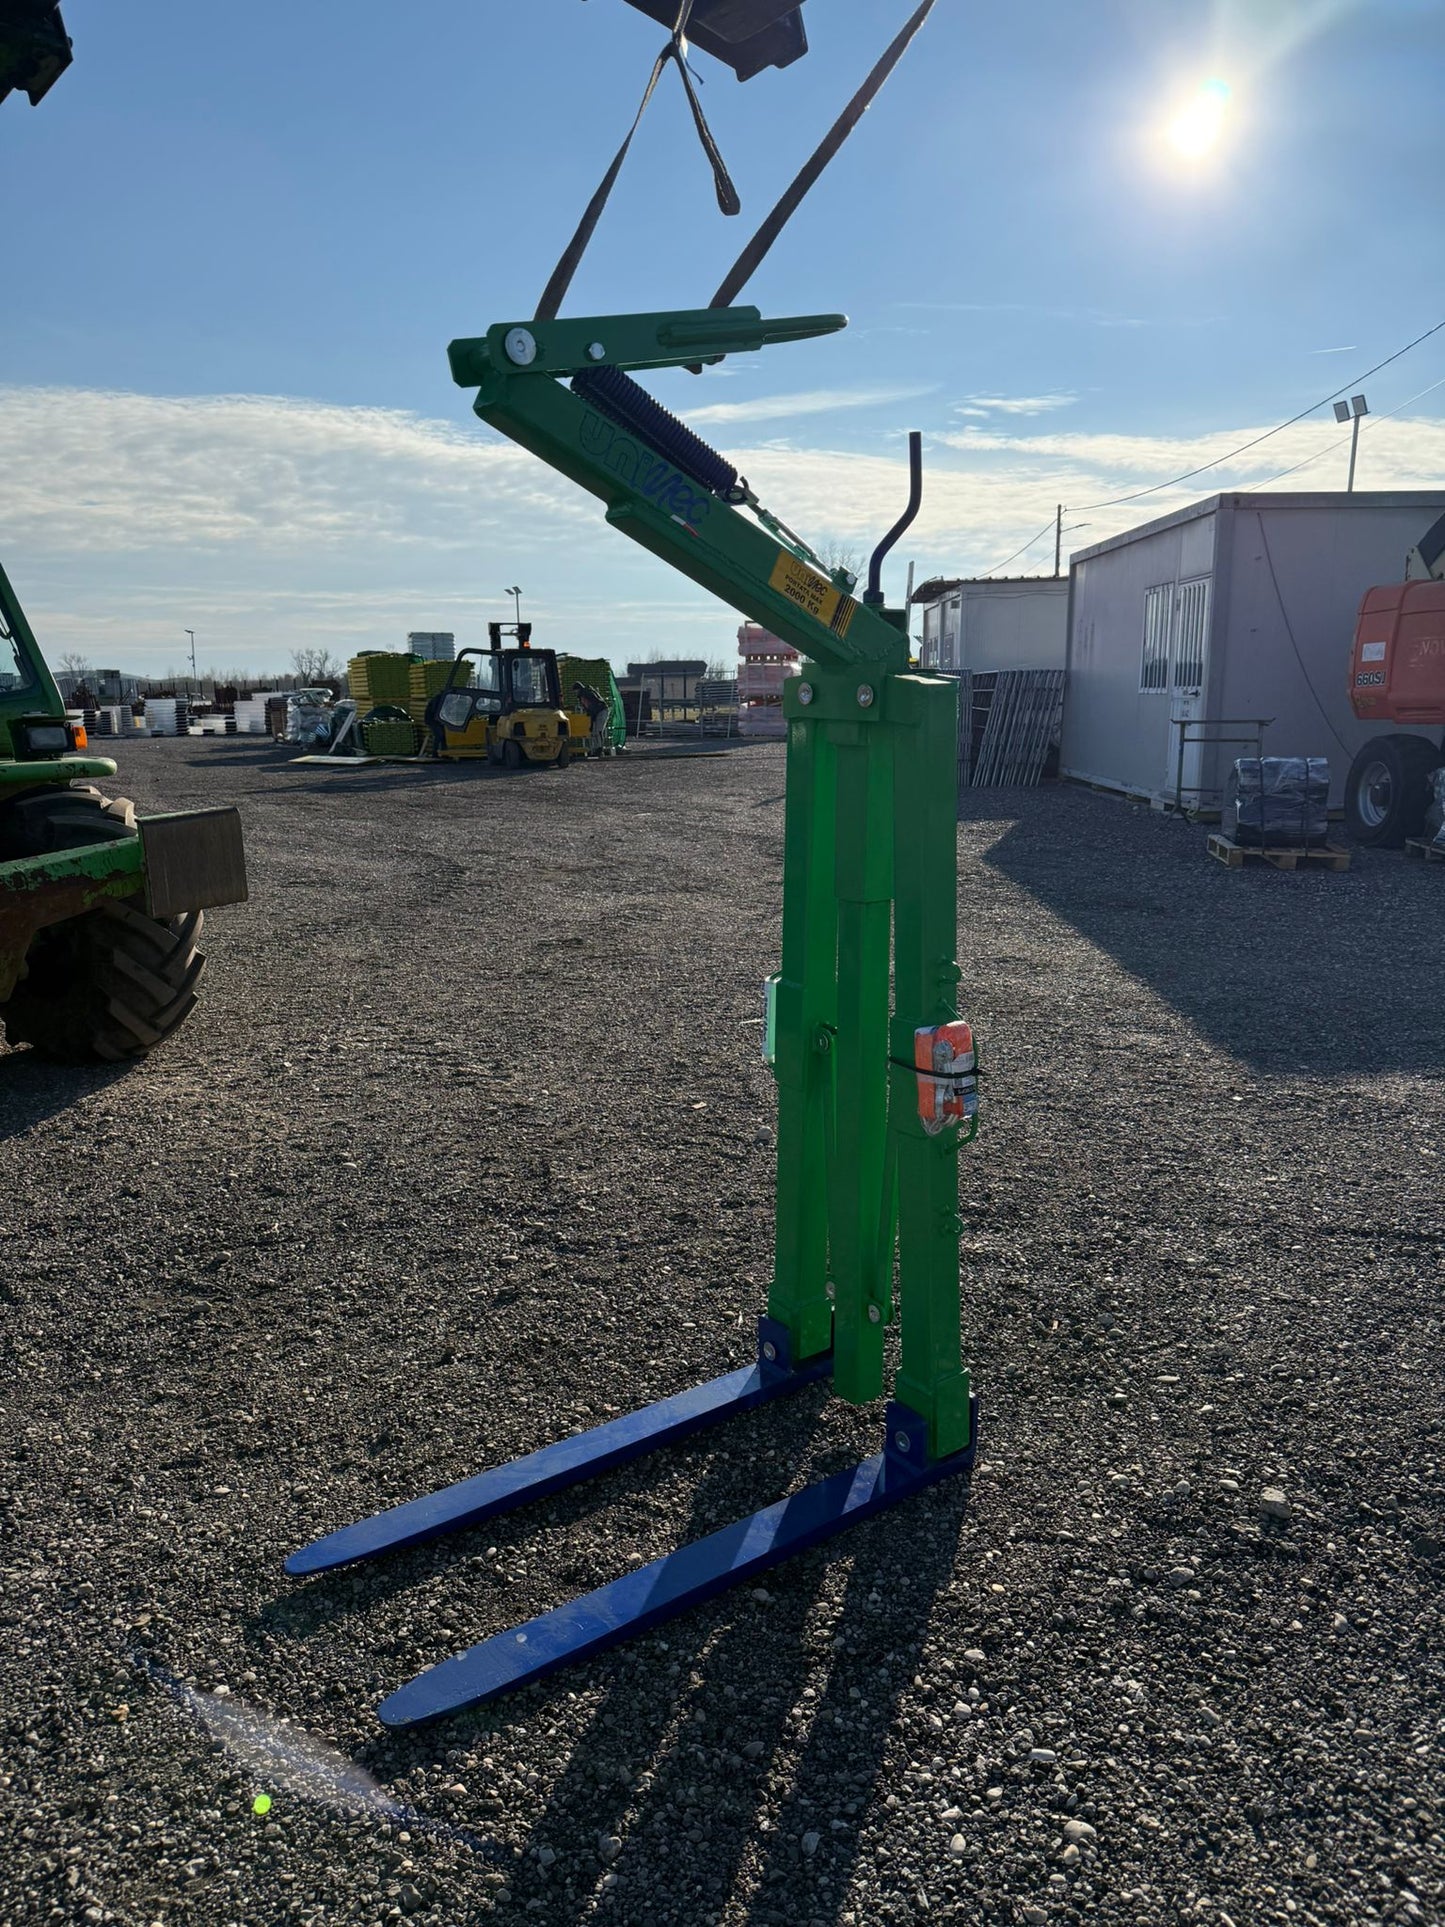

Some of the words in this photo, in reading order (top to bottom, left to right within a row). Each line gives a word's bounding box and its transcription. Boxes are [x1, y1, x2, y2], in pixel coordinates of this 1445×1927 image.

[784, 574, 810, 596] PORTATA
[810, 592, 823, 605] MAX
[784, 584, 805, 603] 2000
[807, 600, 820, 615] Kg
[1356, 671, 1386, 687] 660SJ
